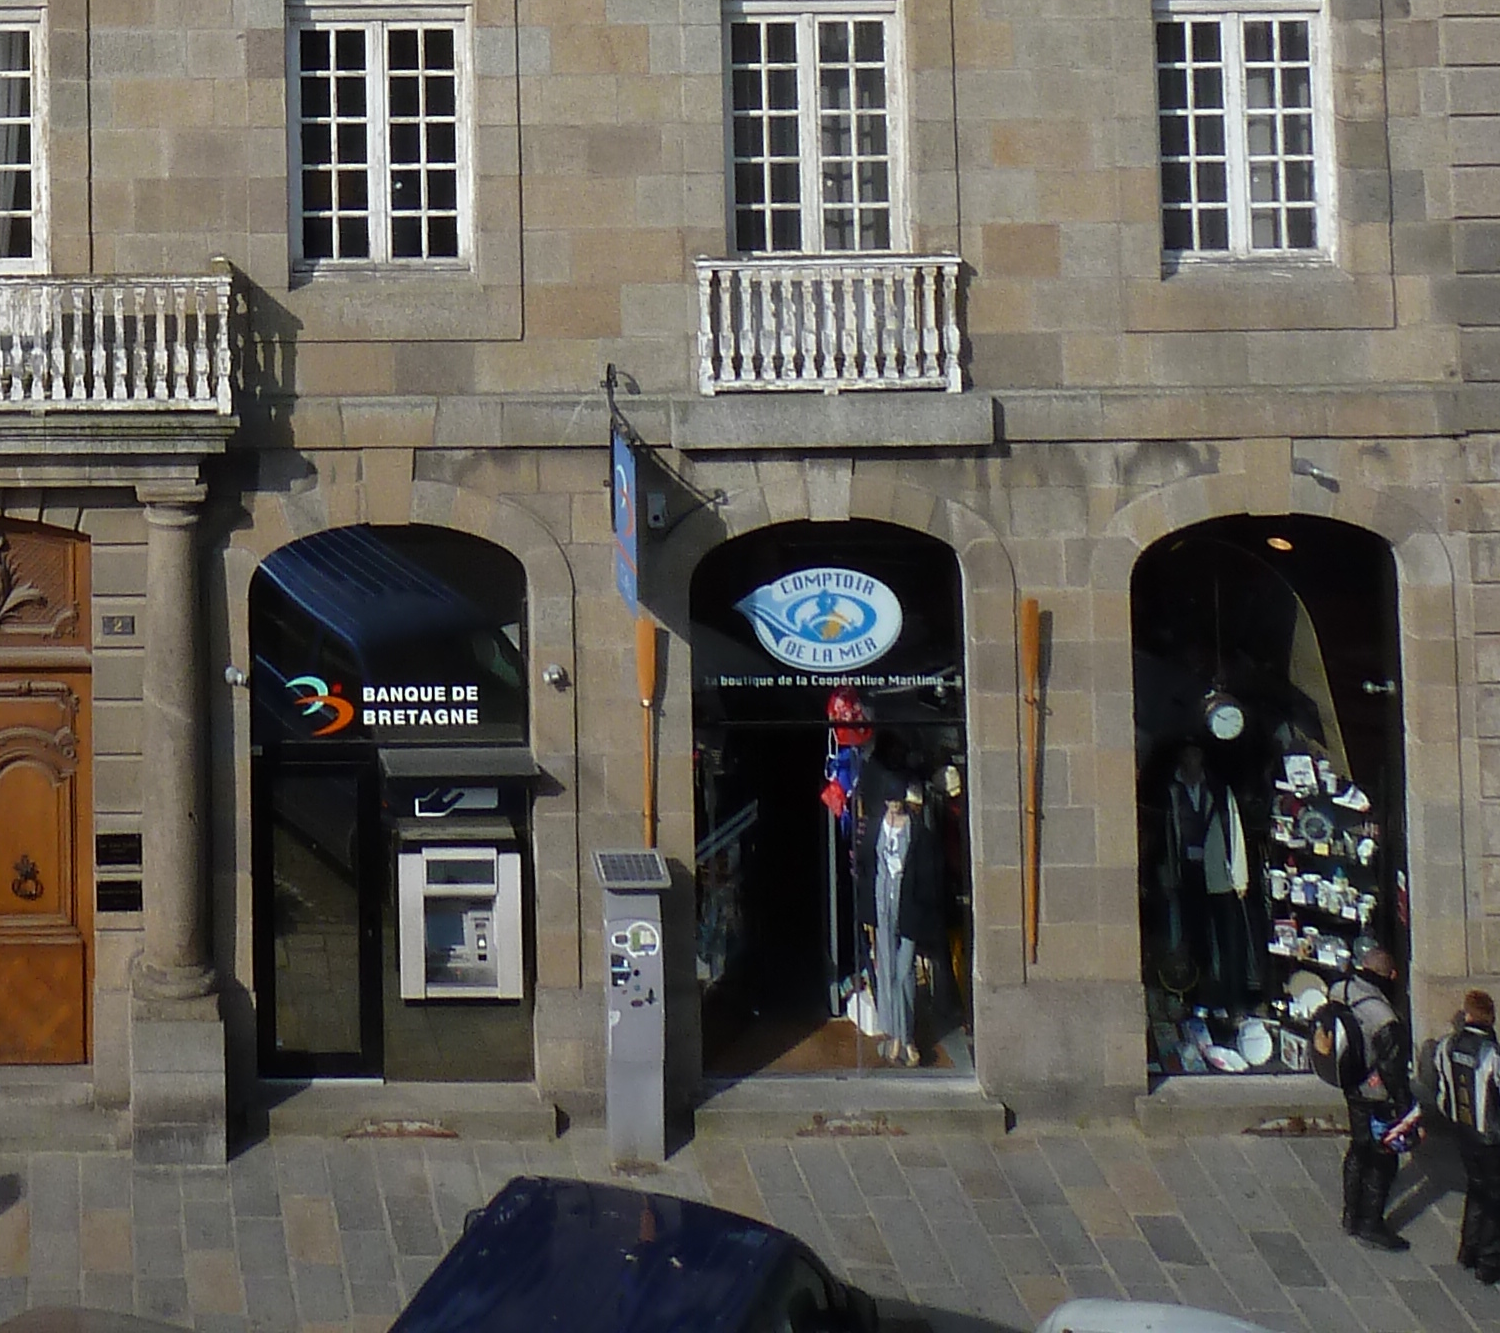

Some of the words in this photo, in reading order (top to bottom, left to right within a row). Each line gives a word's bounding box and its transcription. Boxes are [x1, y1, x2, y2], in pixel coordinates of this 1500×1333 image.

[780, 572, 876, 596] COMPTOIR
[113, 618, 123, 632] 2
[784, 640, 806, 660] DE
[812, 647, 833, 663] LA
[839, 636, 878, 661] MER
[720, 674, 774, 689] boutique
[778, 674, 793, 686] de
[796, 674, 808, 686] la
[811, 673, 886, 688] Coopérative
[888, 674, 944, 686] Maritime
[362, 686, 447, 703] BANQUE
[451, 685, 479, 702] DE
[362, 708, 480, 726] BRETAGNE
